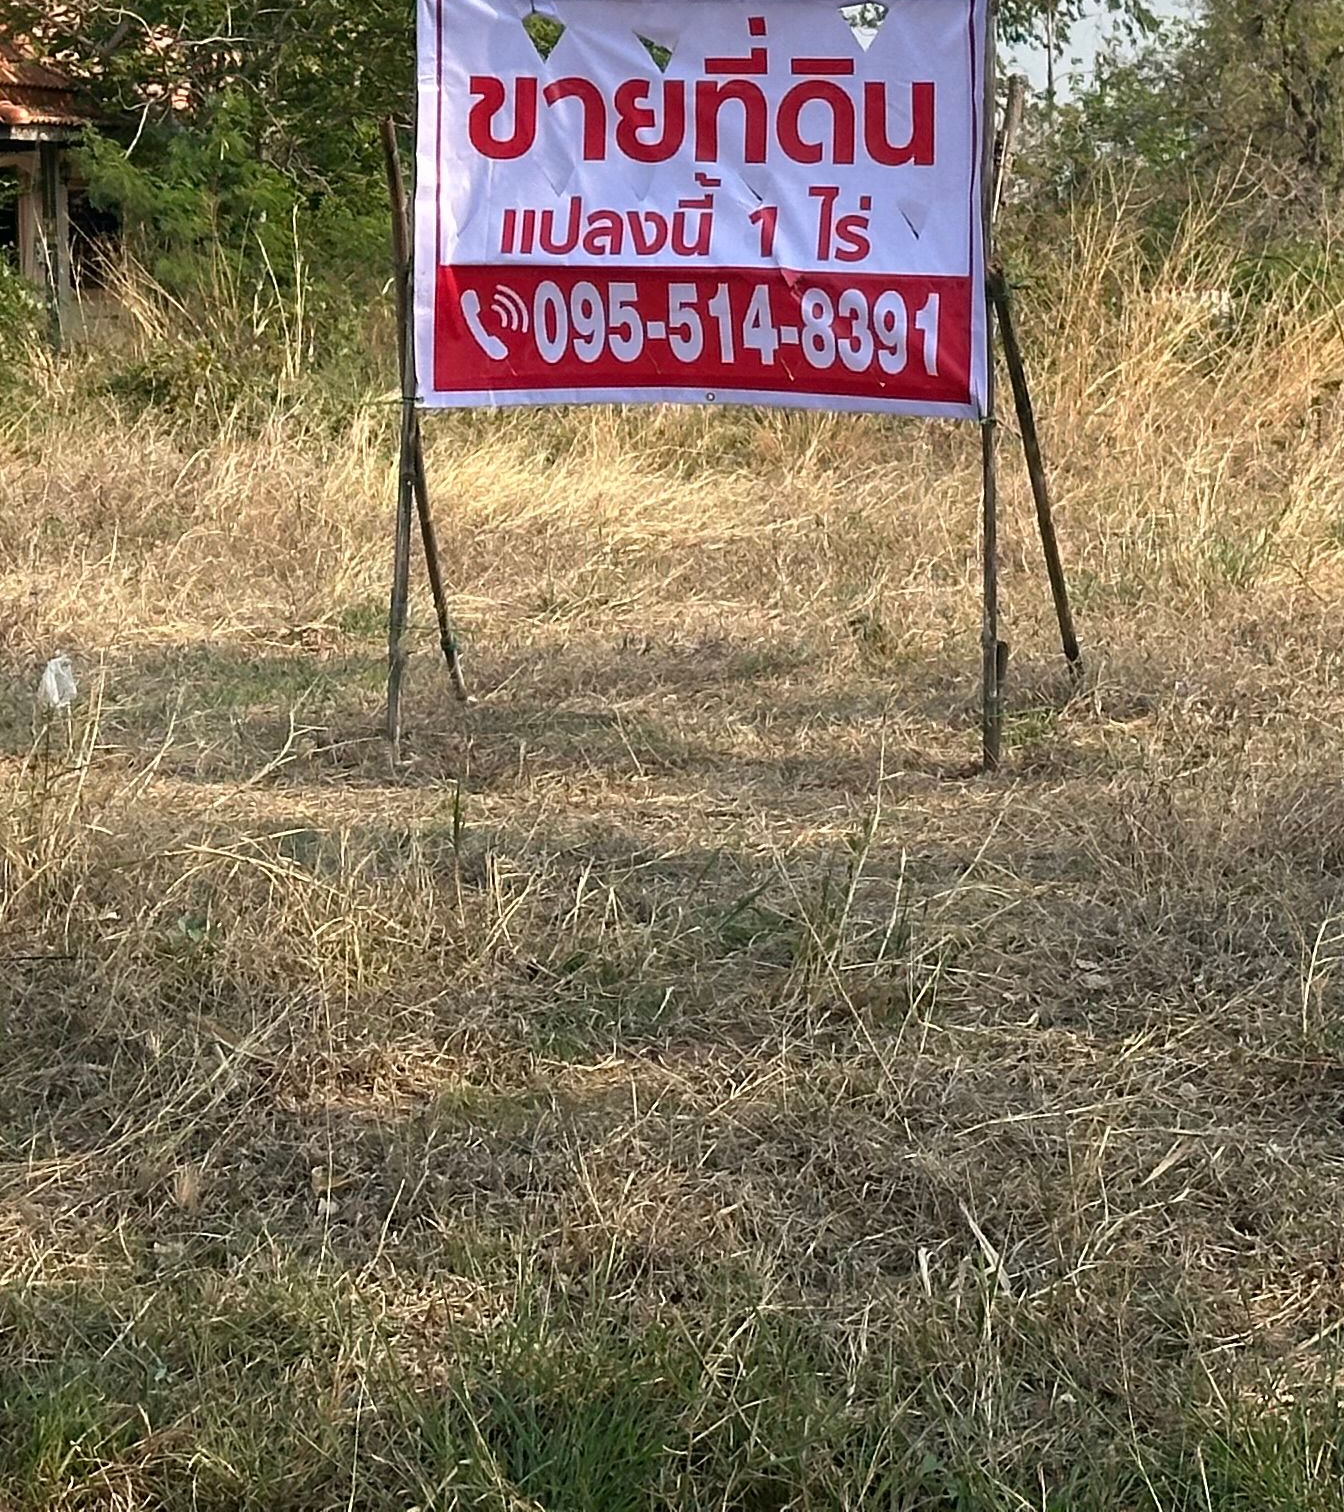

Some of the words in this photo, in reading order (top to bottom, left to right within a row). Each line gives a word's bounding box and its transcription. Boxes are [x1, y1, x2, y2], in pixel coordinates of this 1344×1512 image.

[468, 16, 935, 167] ขายที่ดิน
[500, 172, 721, 256] แปลงนี้
[748, 205, 778, 258] 1
[808, 186, 872, 262] ไร่
[533, 279, 940, 377] 095-514-8391
